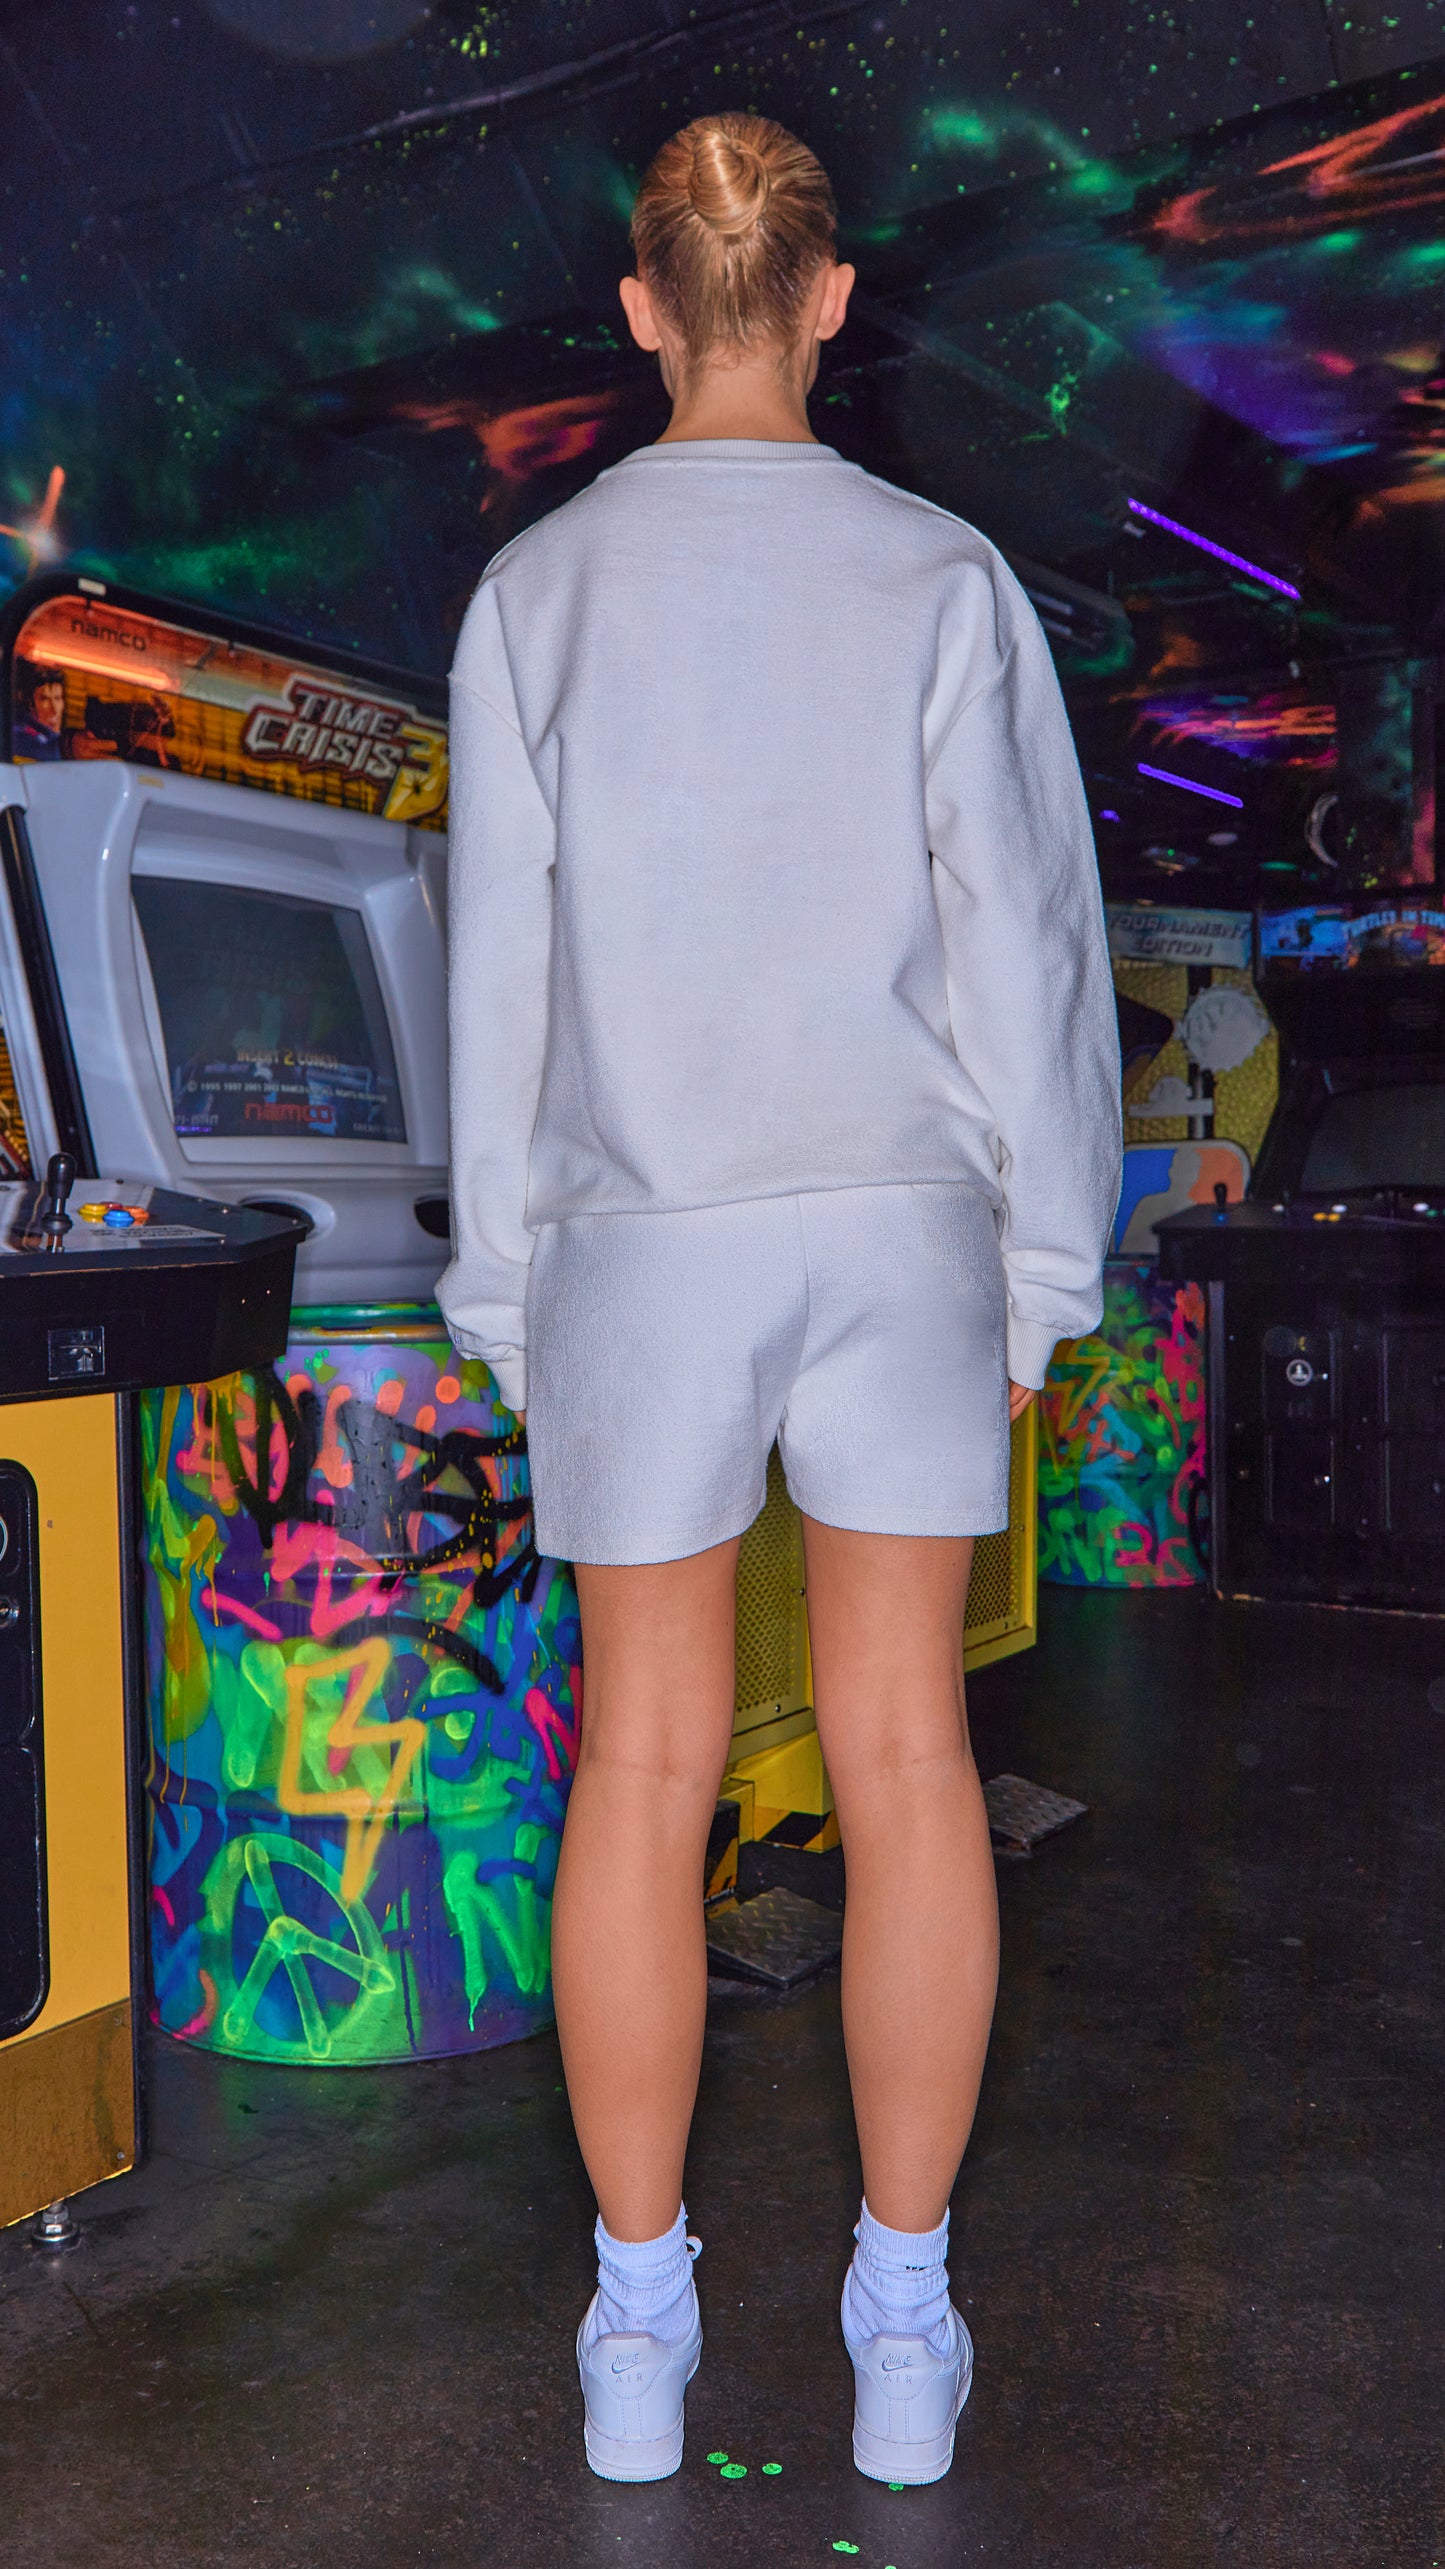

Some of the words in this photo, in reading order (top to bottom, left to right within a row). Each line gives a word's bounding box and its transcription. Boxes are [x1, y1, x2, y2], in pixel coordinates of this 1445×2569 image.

[70, 616, 149, 652] namco
[295, 688, 401, 740] TIME
[246, 711, 403, 779] CRISIS
[383, 721, 449, 820] 3
[284, 1049, 295, 1067] 2
[245, 1102, 336, 1124] namco
[614, 2352, 640, 2366] NIKE
[885, 2352, 912, 2366] NIKE
[616, 2372, 643, 2384] AIR
[884, 2373, 912, 2384] AIR
